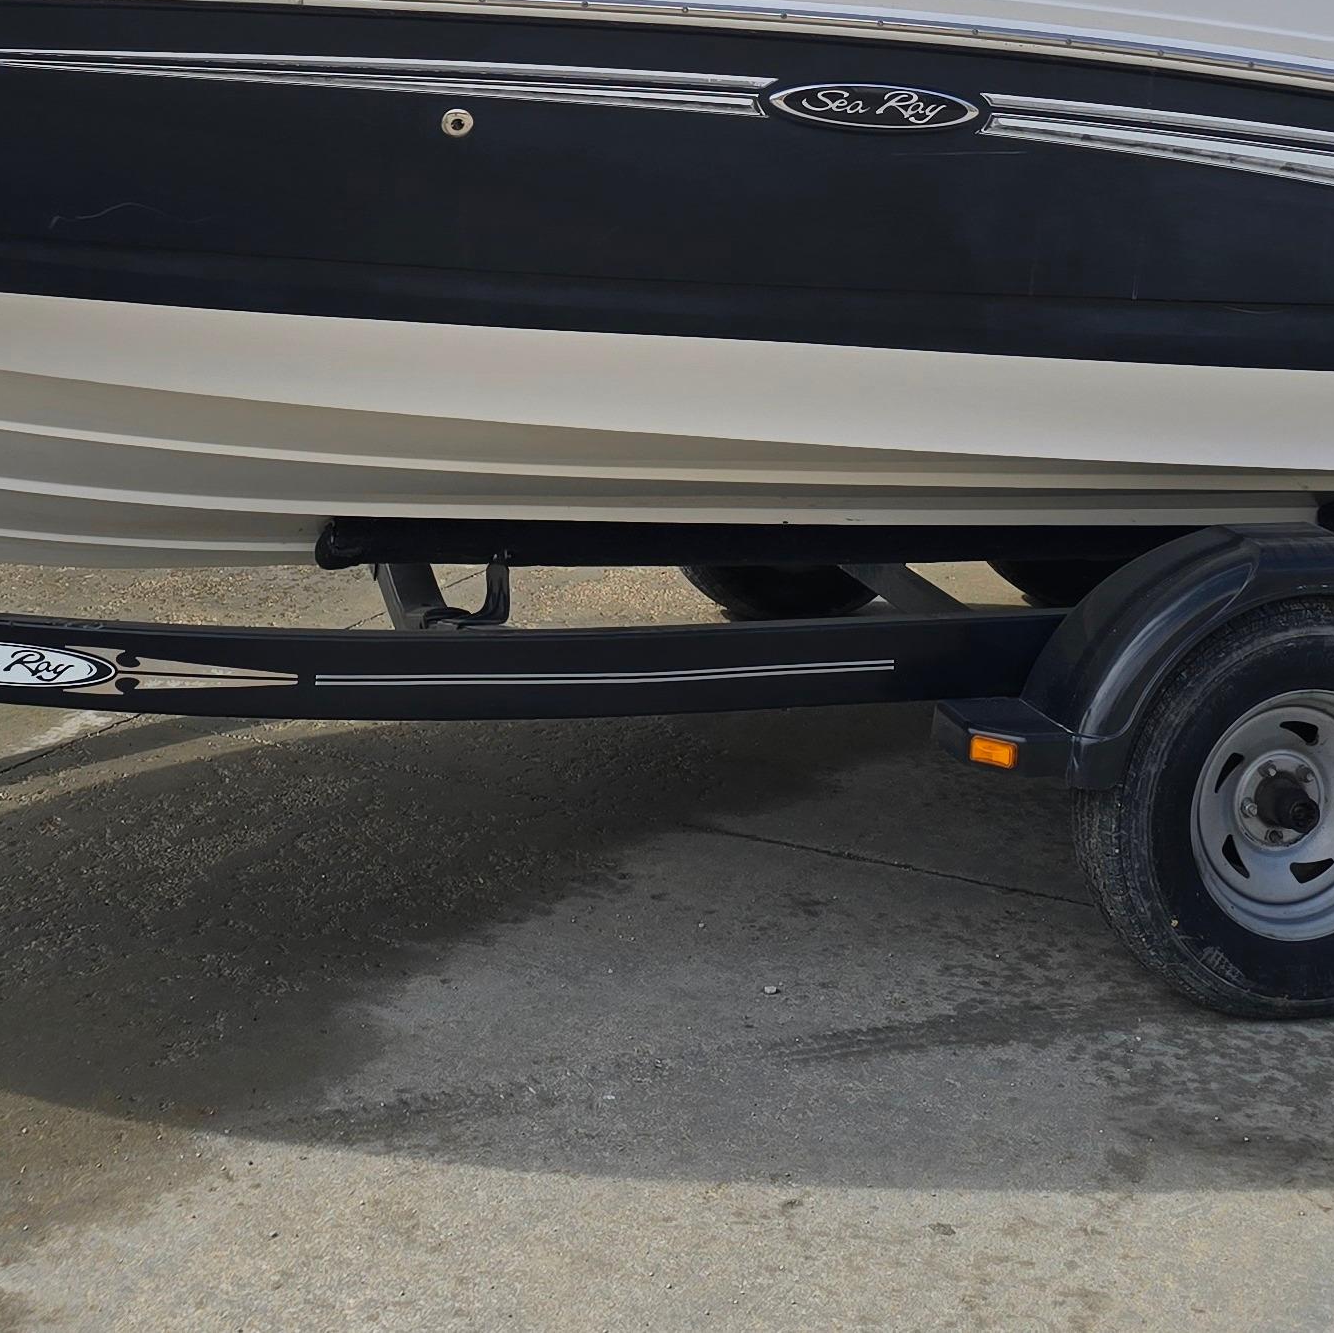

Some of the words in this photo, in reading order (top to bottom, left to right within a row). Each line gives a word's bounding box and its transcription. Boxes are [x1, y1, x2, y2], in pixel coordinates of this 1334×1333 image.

[801, 89, 870, 115] Sea
[875, 90, 947, 124] Ray
[3, 649, 75, 682] Ray
